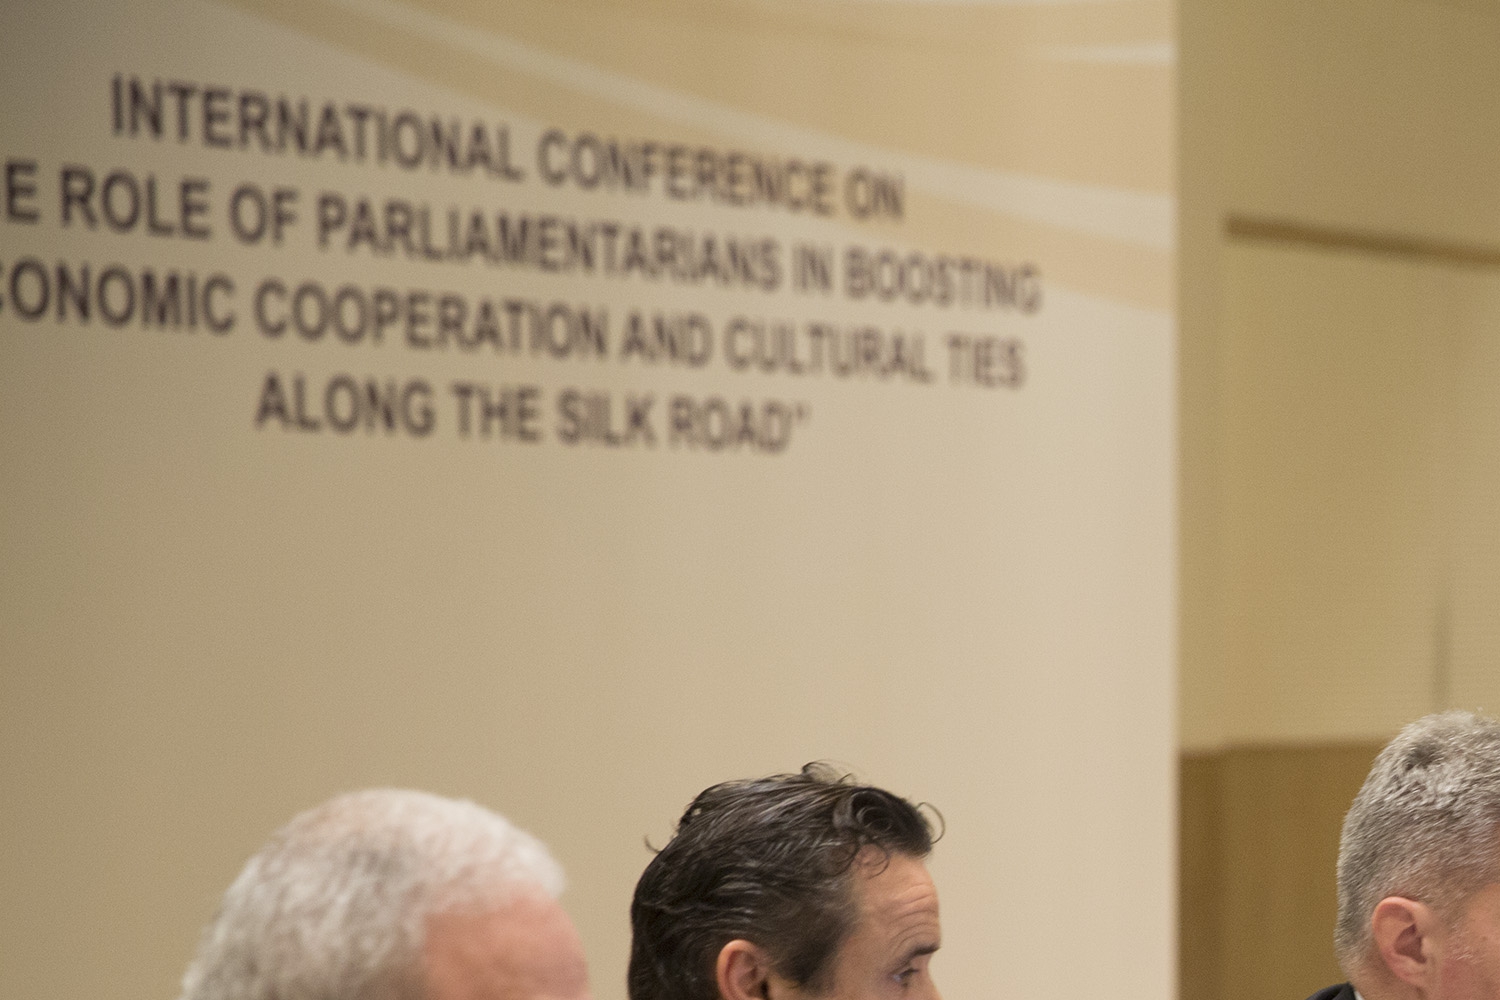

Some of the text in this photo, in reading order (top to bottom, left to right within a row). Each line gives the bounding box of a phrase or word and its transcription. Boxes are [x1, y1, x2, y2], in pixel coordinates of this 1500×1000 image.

[110, 72, 907, 222] INTERNATIONAL CONFERENCE ON
[60, 162, 211, 242] ROLE
[228, 181, 299, 247] OF
[317, 191, 783, 295] PARLIAMENTARIANS
[791, 240, 835, 296] IN
[843, 245, 1045, 317] BOOSTING
[0, 255, 1027, 391] ONOMIC COOPERATION AND CULTURAL TIES
[254, 368, 438, 440] ALONG
[449, 379, 545, 443] THE
[555, 387, 657, 449] SILK
